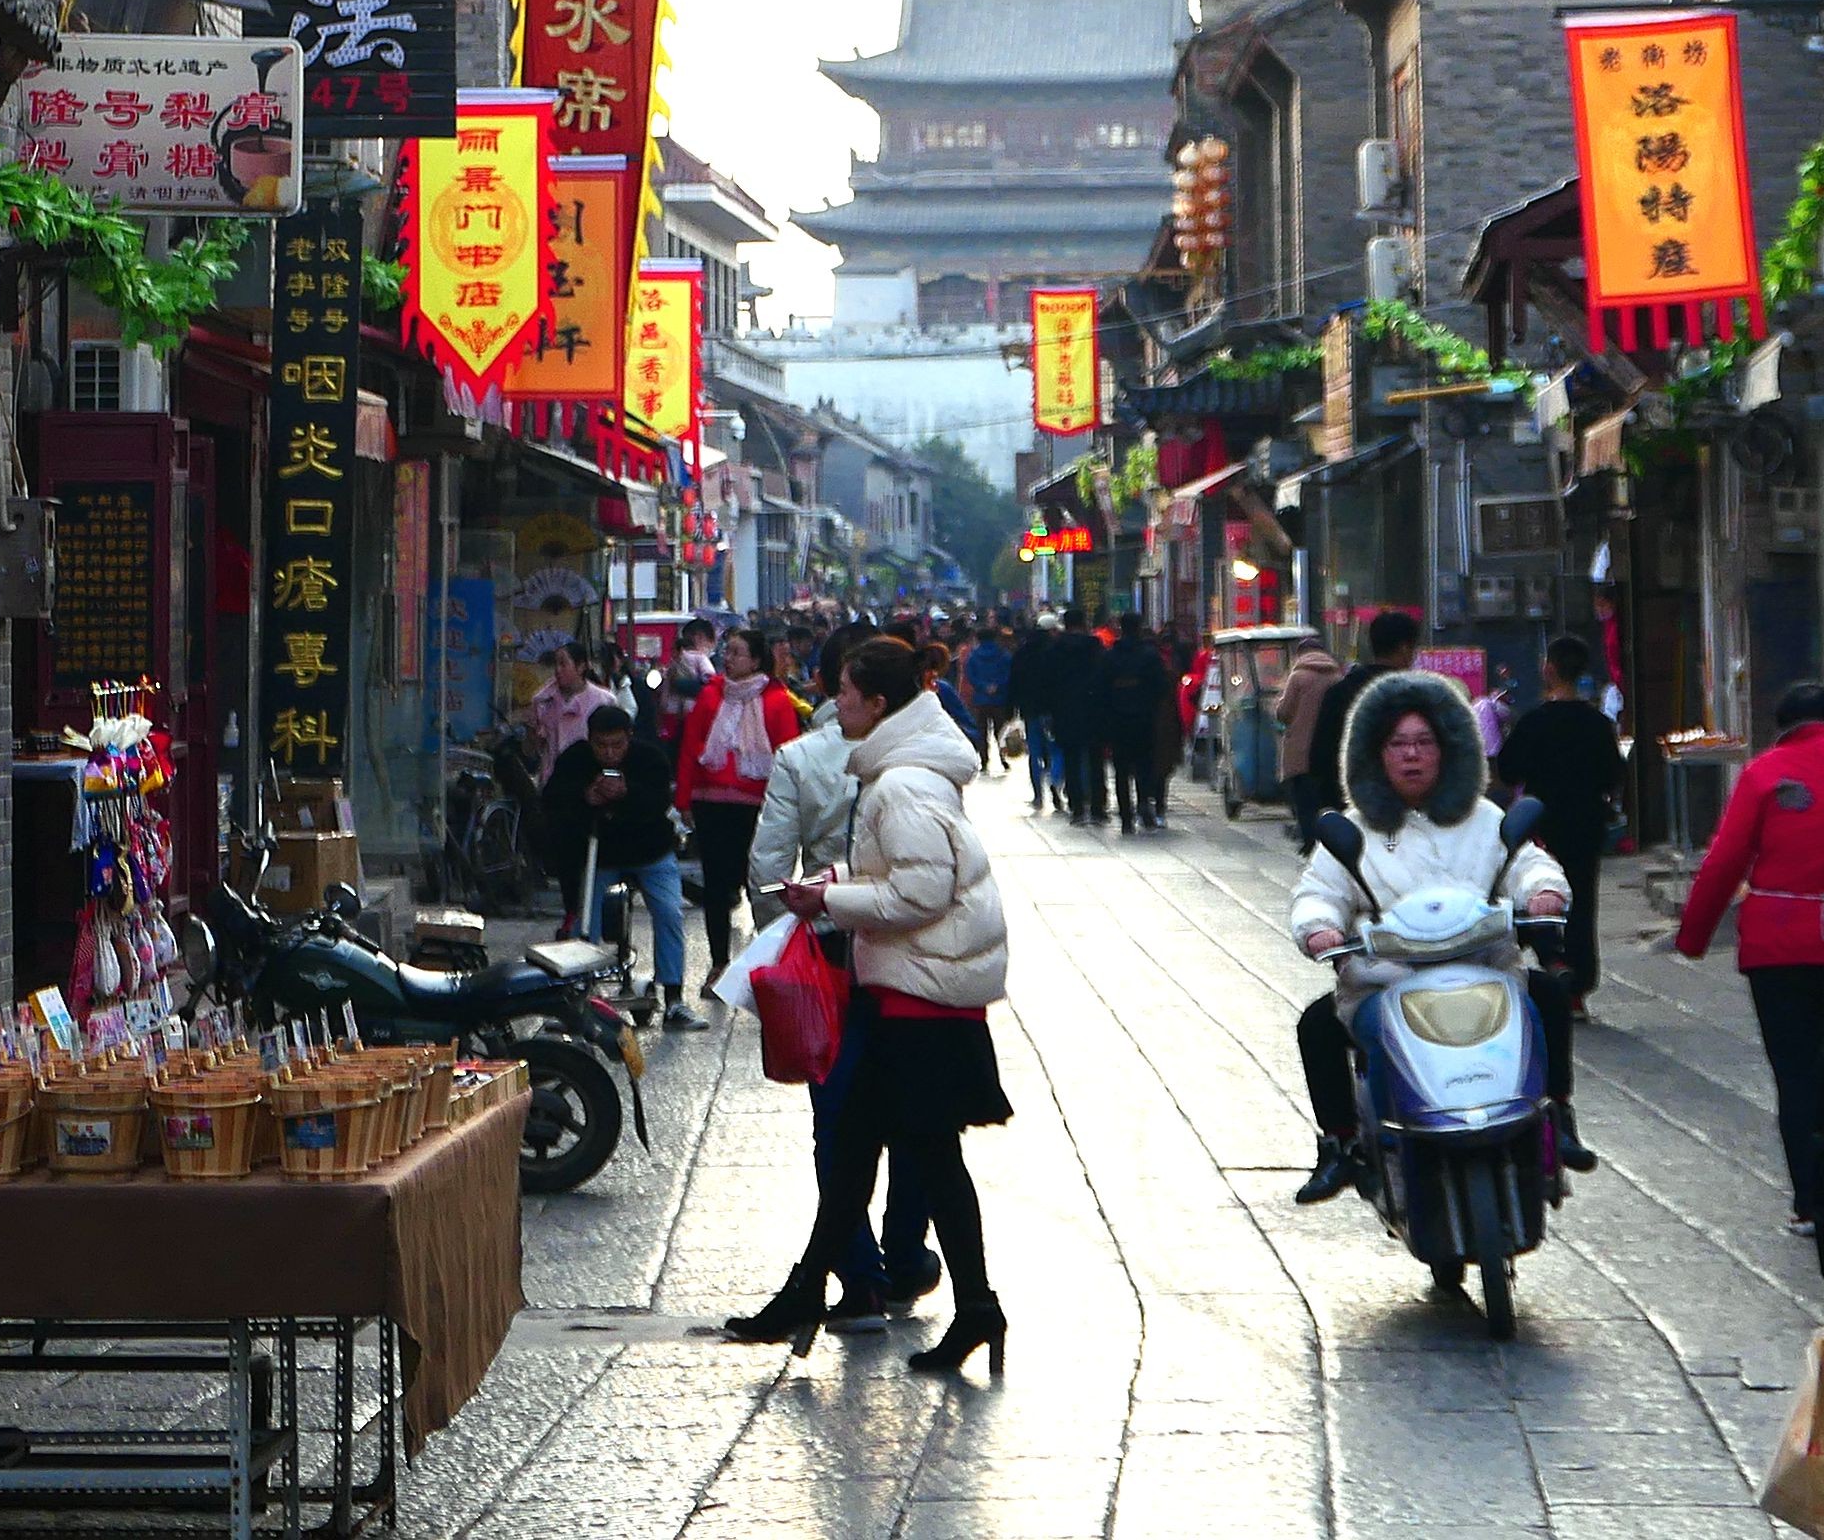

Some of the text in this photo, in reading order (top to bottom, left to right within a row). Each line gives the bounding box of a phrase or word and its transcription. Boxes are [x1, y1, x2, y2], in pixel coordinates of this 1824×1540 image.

[309, 74, 415, 115] 47号
[19, 139, 222, 181] 梨膏糖
[285, 236, 316, 333] 老字号
[321, 237, 351, 333] 双隆号
